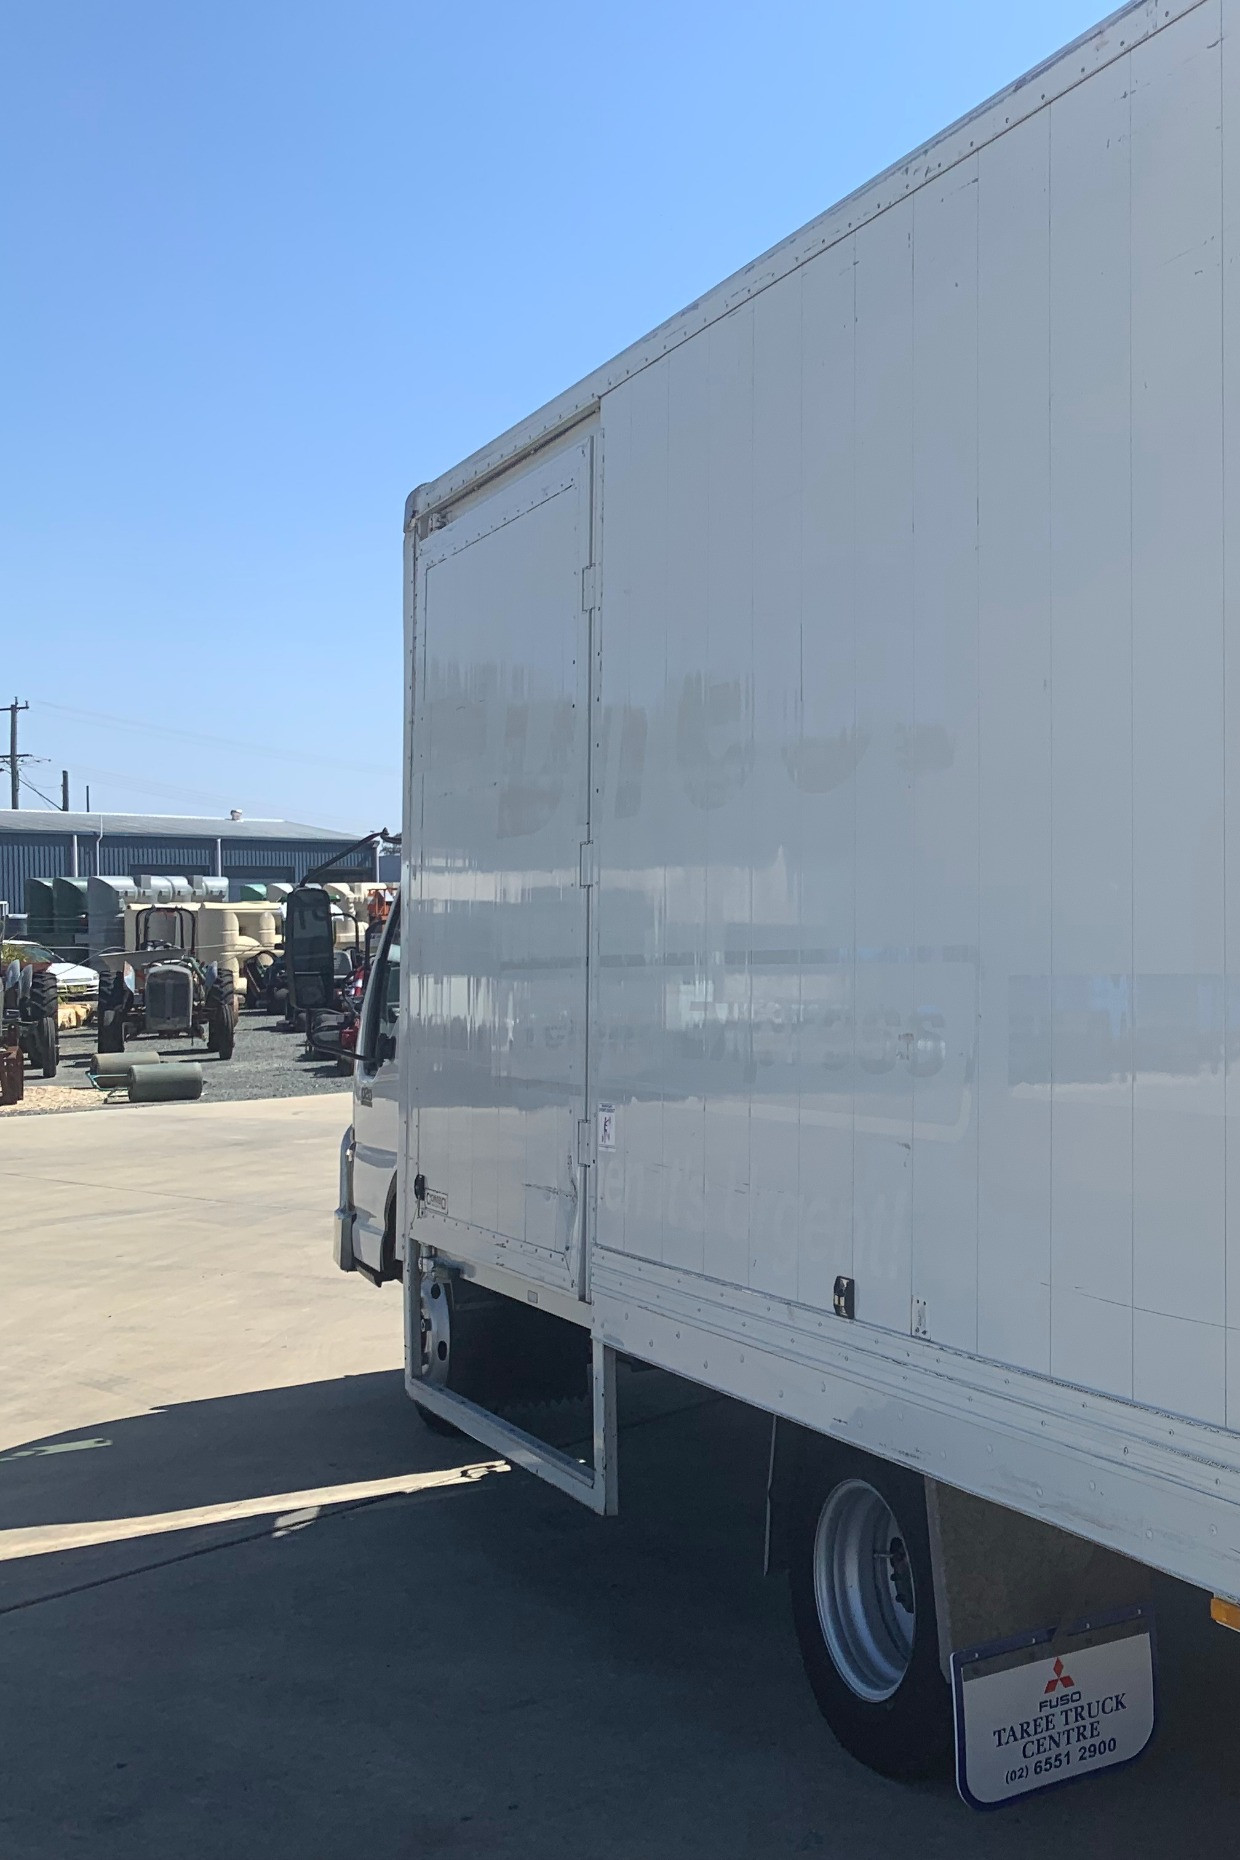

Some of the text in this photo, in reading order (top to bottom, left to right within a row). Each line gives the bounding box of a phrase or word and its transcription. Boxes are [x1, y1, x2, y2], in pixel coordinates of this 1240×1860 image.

[993, 1692, 1127, 1748] TAREE TRUCK
[1039, 1691, 1081, 1712] FUSO
[1005, 1737, 1117, 1784] (02) 6551 2900
[1022, 1720, 1100, 1759] CENTRE
